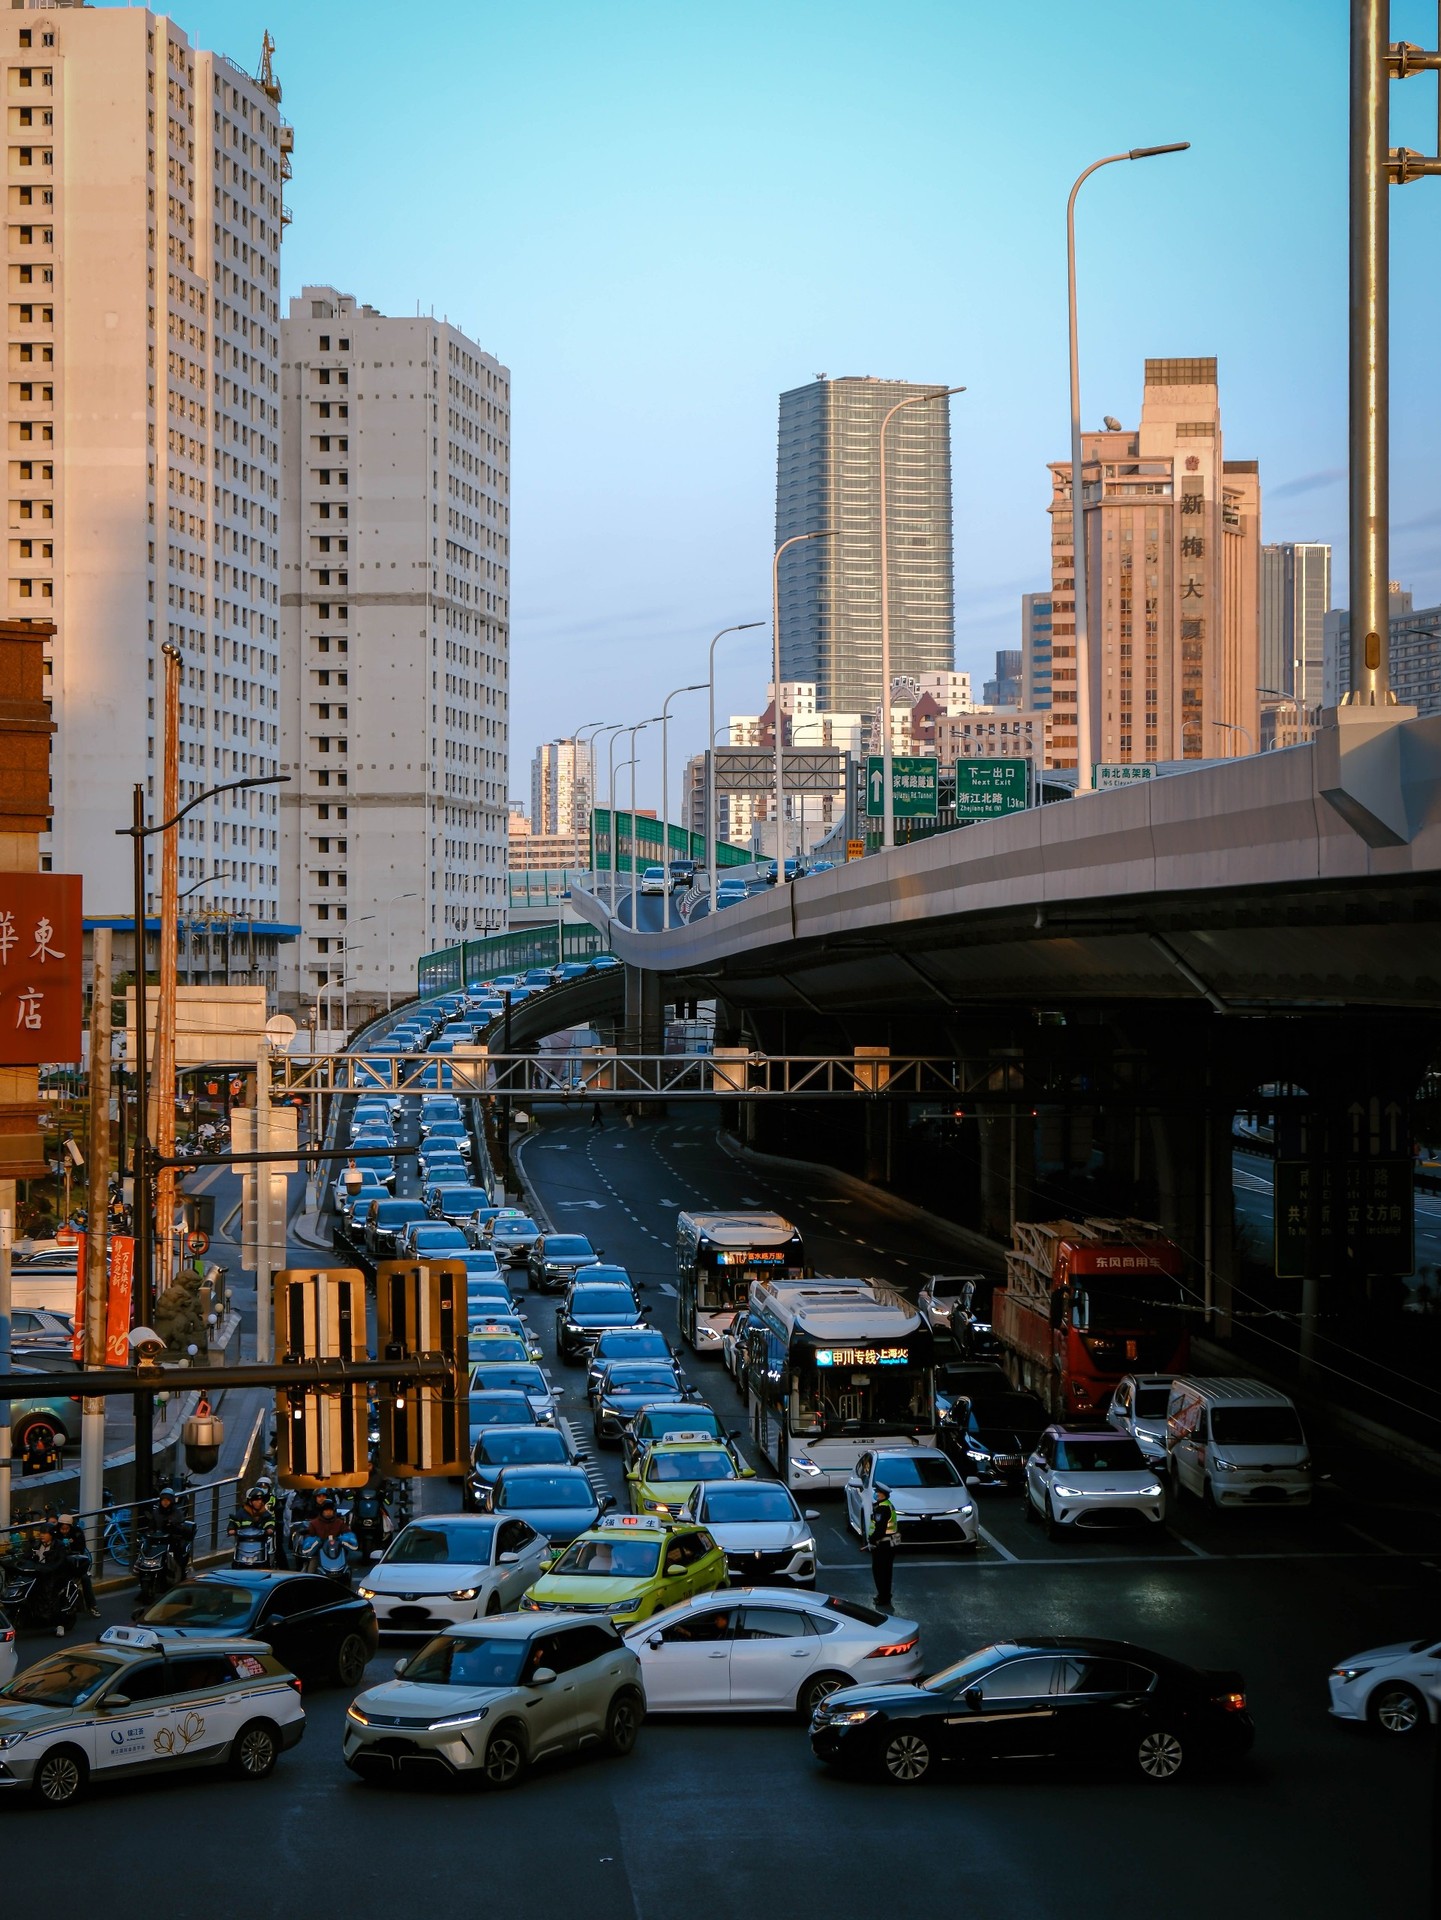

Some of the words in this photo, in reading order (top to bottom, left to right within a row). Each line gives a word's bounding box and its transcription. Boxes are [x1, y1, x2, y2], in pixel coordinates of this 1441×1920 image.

[968, 767, 1015, 778] 下一出口
[1101, 768, 1151, 778] 南北高架路
[893, 775, 935, 788] 家嘴路隧道
[959, 792, 1003, 804] 浙江北路
[16, 986, 44, 1029] 店
[1096, 1256, 1160, 1268] 东风商用车
[832, 1349, 876, 1366] 申川专线
